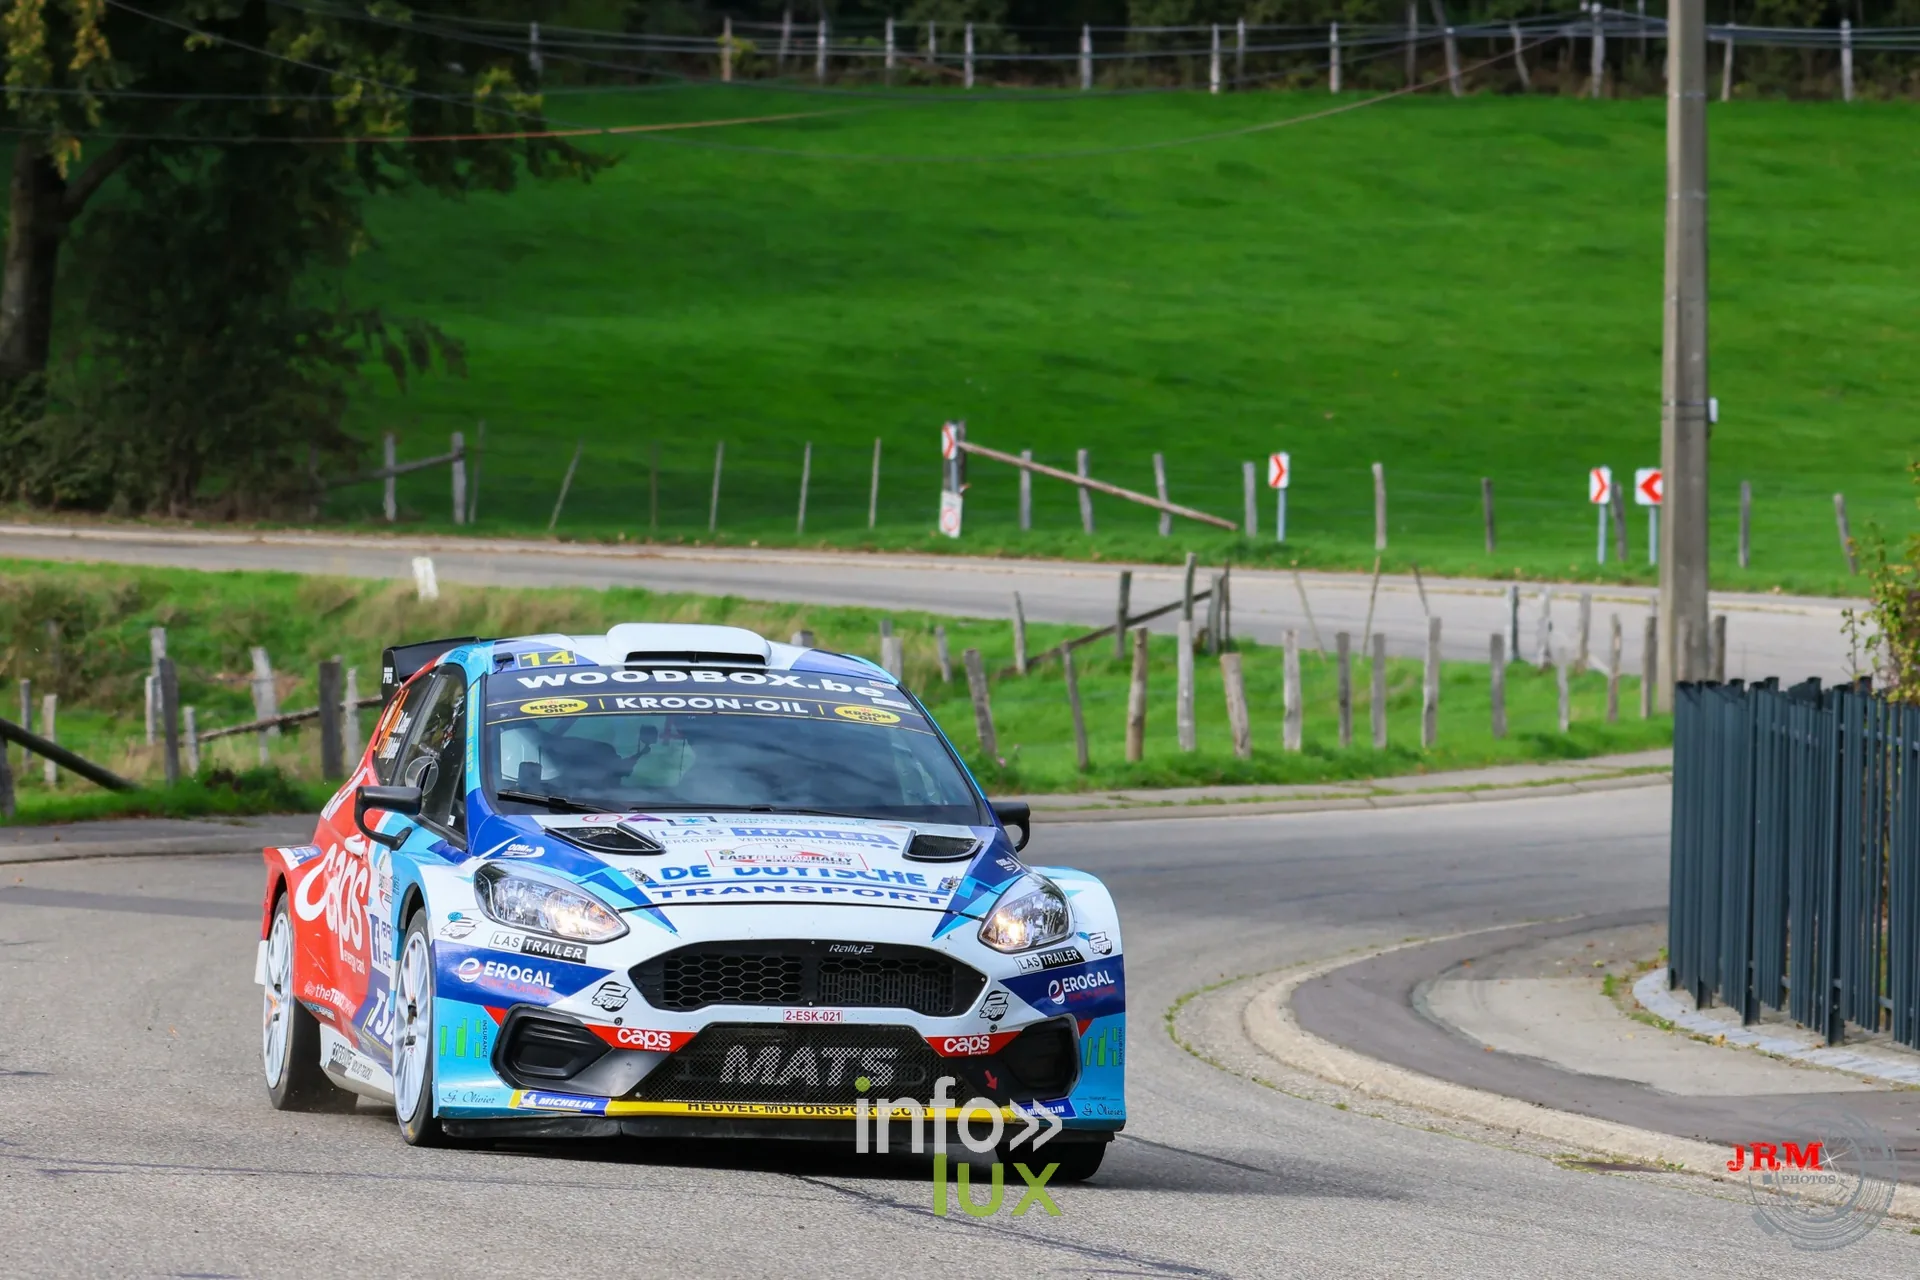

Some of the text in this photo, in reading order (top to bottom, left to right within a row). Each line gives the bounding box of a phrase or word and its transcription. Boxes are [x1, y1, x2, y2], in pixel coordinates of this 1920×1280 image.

[523, 651, 574, 667] 14
[517, 670, 885, 698] WOODBOX.be
[615, 697, 808, 714] KROON-OIL
[844, 709, 891, 719] KROON
[738, 828, 882, 842] TRAILER
[661, 865, 711, 880] DE
[651, 885, 948, 905] TRANSPORT
[493, 933, 584, 959] LAS TRAILER
[829, 944, 875, 955] Rally2
[1019, 949, 1080, 970] LAS TRAILER
[483, 960, 555, 989] EROGAL
[1062, 970, 1115, 993] EROGAL
[785, 1010, 842, 1022] 2-ESK-021
[617, 1028, 671, 1049] caps
[943, 1035, 990, 1055] caps
[720, 1045, 897, 1087] MATS
[538, 1096, 596, 1109] MICHELIN
[1096, 1103, 1123, 1116] Olivier
